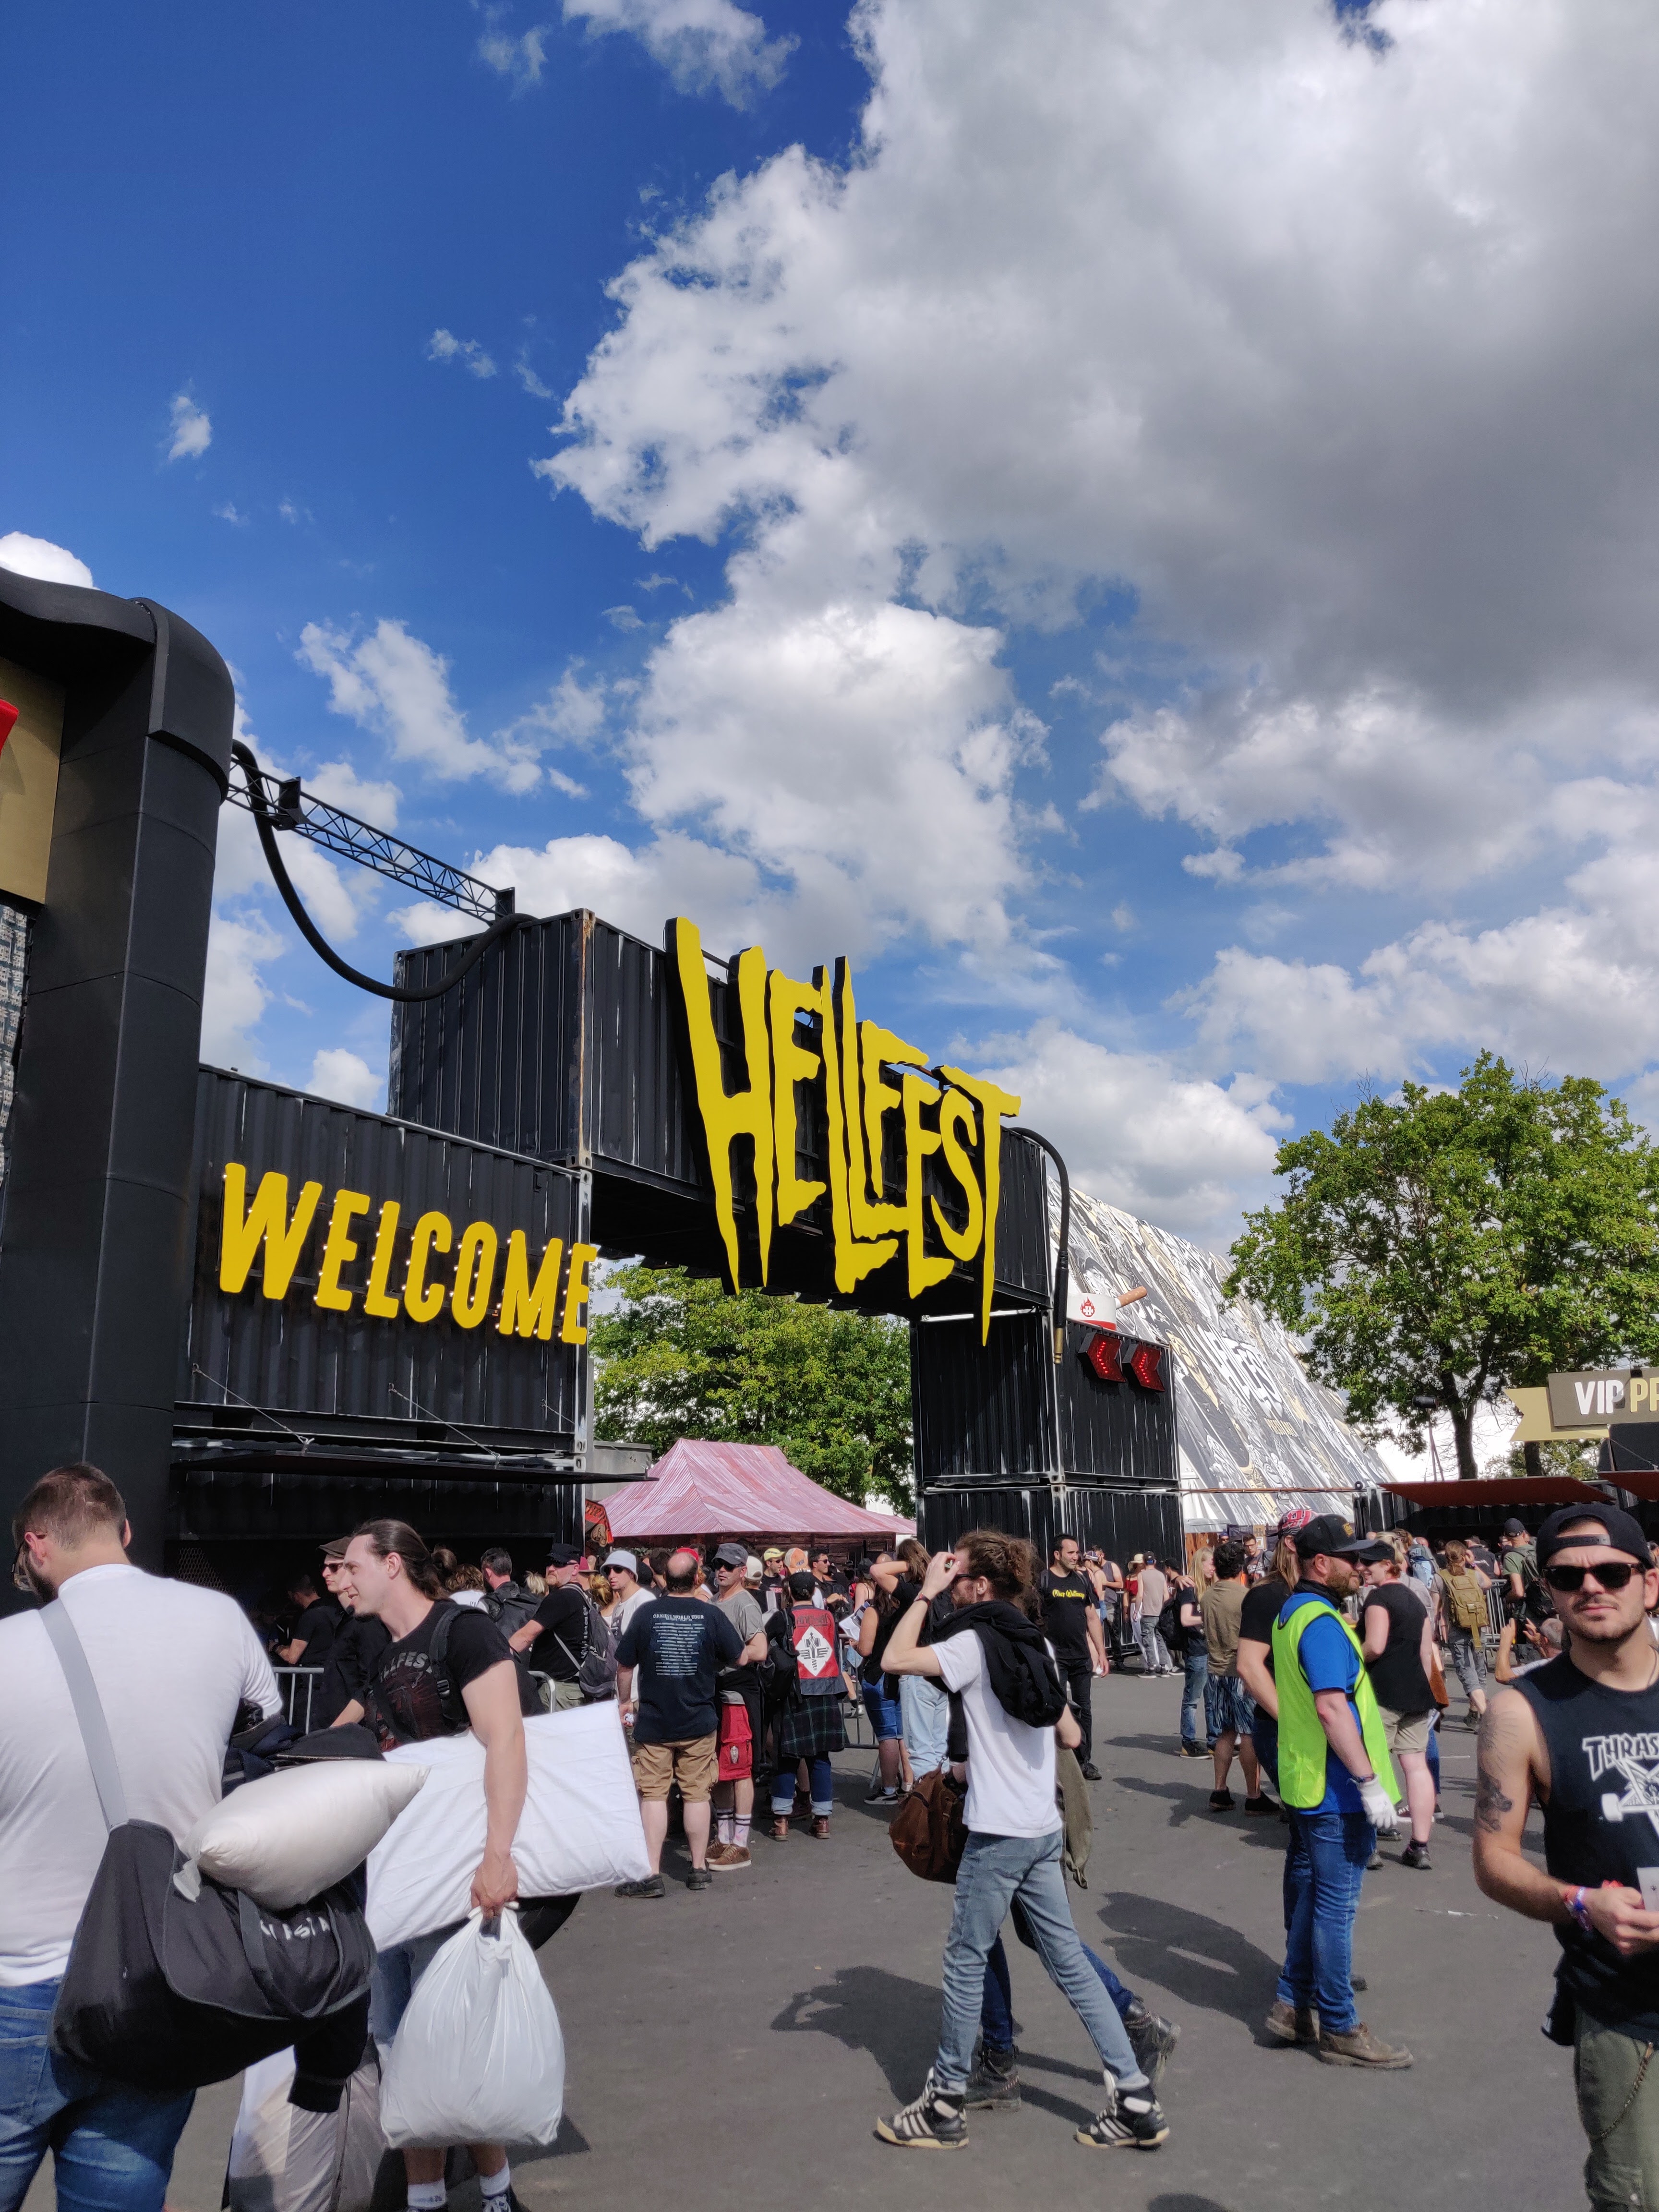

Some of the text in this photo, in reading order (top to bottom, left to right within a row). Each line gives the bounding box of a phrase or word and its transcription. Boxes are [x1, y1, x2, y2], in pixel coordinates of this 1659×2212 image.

[676, 917, 1021, 1346] HELLFEST
[219, 1162, 597, 1345] WELCOME
[1575, 1380, 1624, 1415] VIP
